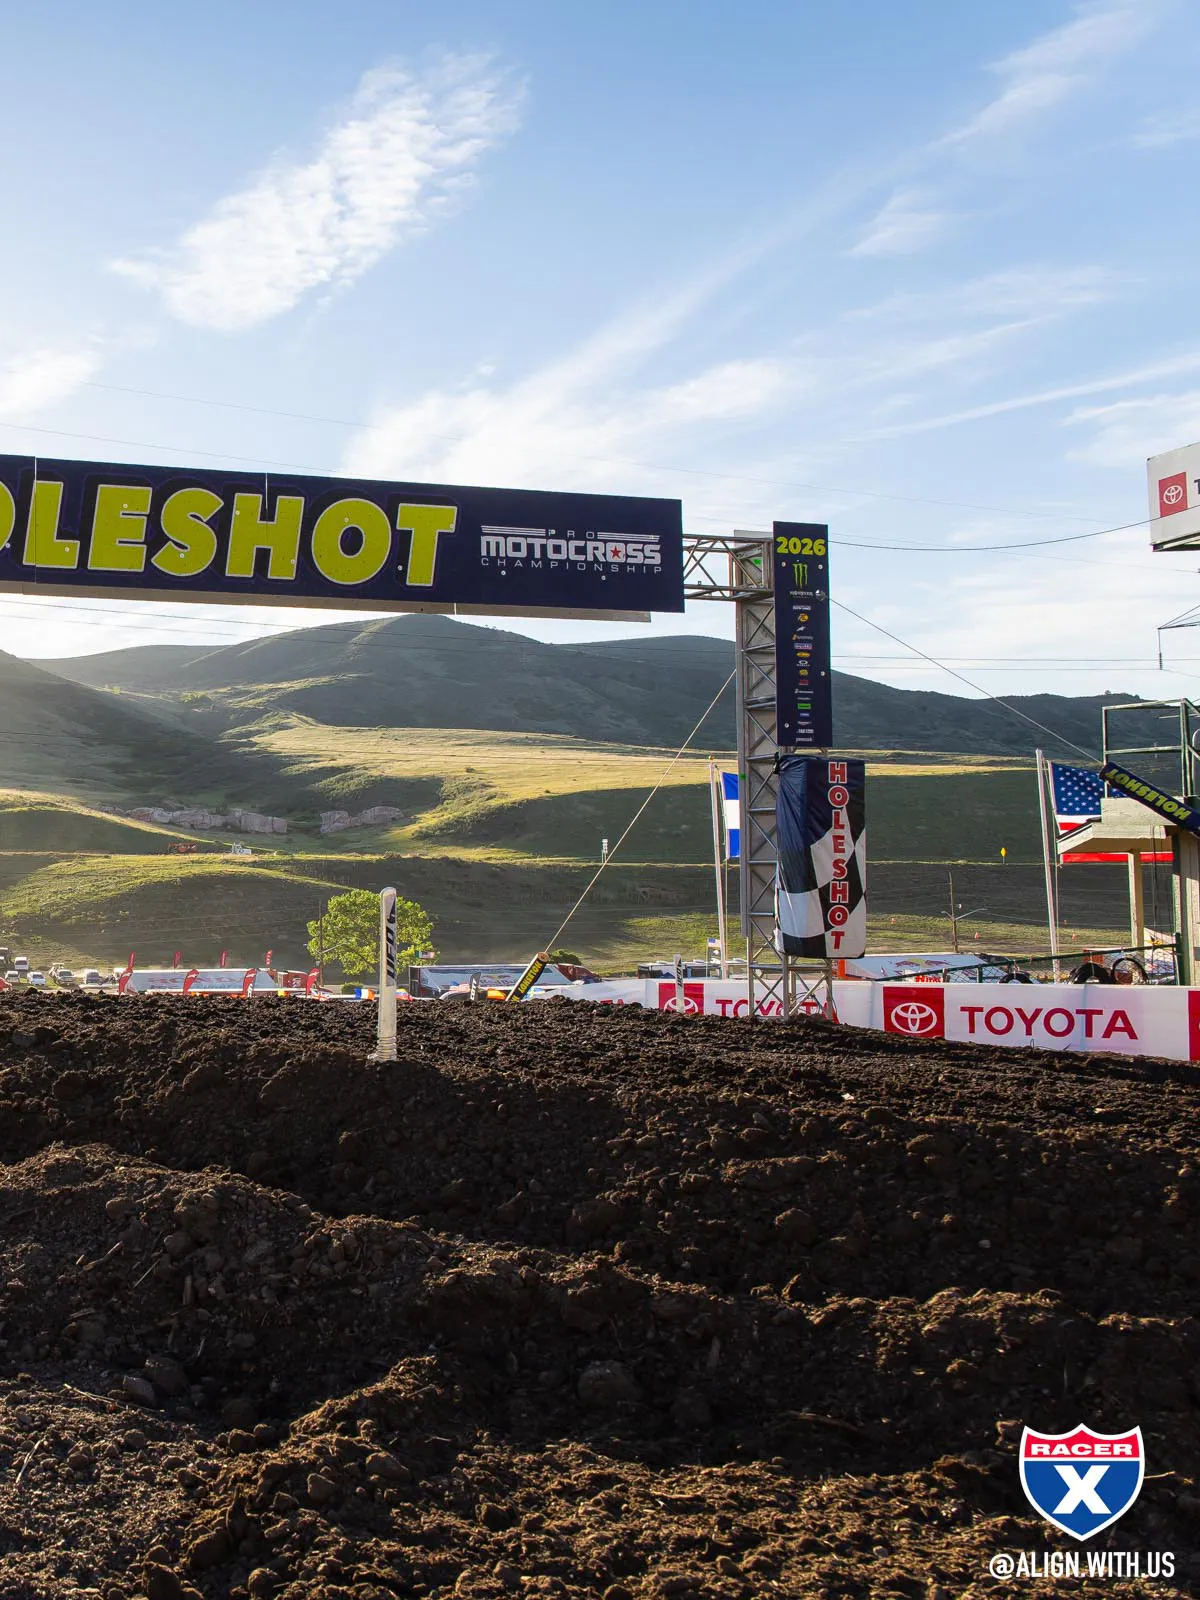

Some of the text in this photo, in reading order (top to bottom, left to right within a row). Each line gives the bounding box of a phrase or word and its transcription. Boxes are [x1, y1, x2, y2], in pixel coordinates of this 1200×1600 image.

[481, 535, 662, 565] MOTOCROSS
[548, 529, 595, 539] PRO
[776, 536, 826, 556] 2026
[481, 557, 662, 574] CHAMPIONSHIP
[1105, 769, 1191, 820] HOLESHOT
[828, 761, 850, 950] HOLESHOT
[518, 960, 543, 994] HOLESHOT
[960, 1005, 1139, 1041] TOYOTA
